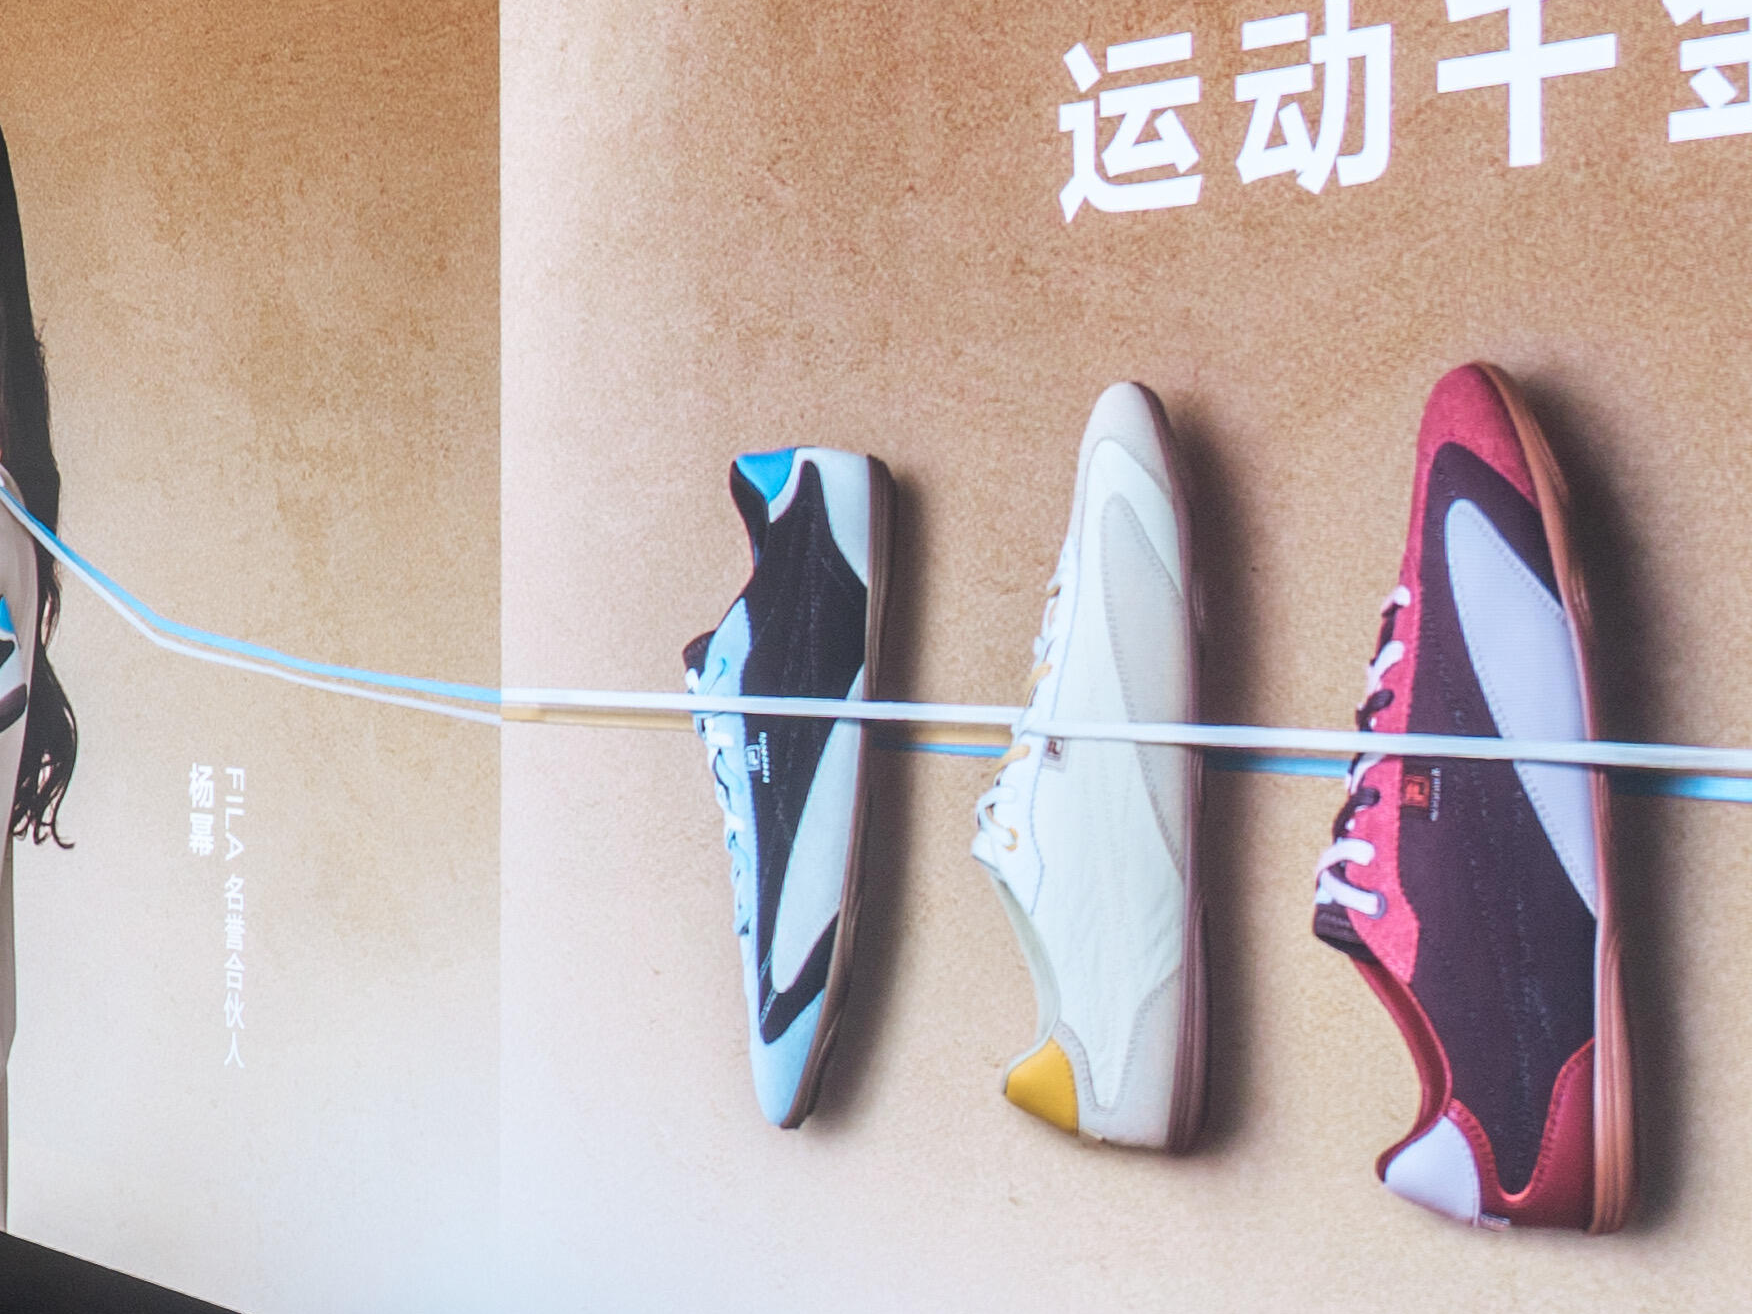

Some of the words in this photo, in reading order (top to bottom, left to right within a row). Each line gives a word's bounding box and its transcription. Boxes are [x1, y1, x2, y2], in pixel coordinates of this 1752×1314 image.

[188, 763, 215, 856] 杨幂
[224, 767, 244, 862] FILA
[223, 873, 245, 1068] 名誉合伙人
